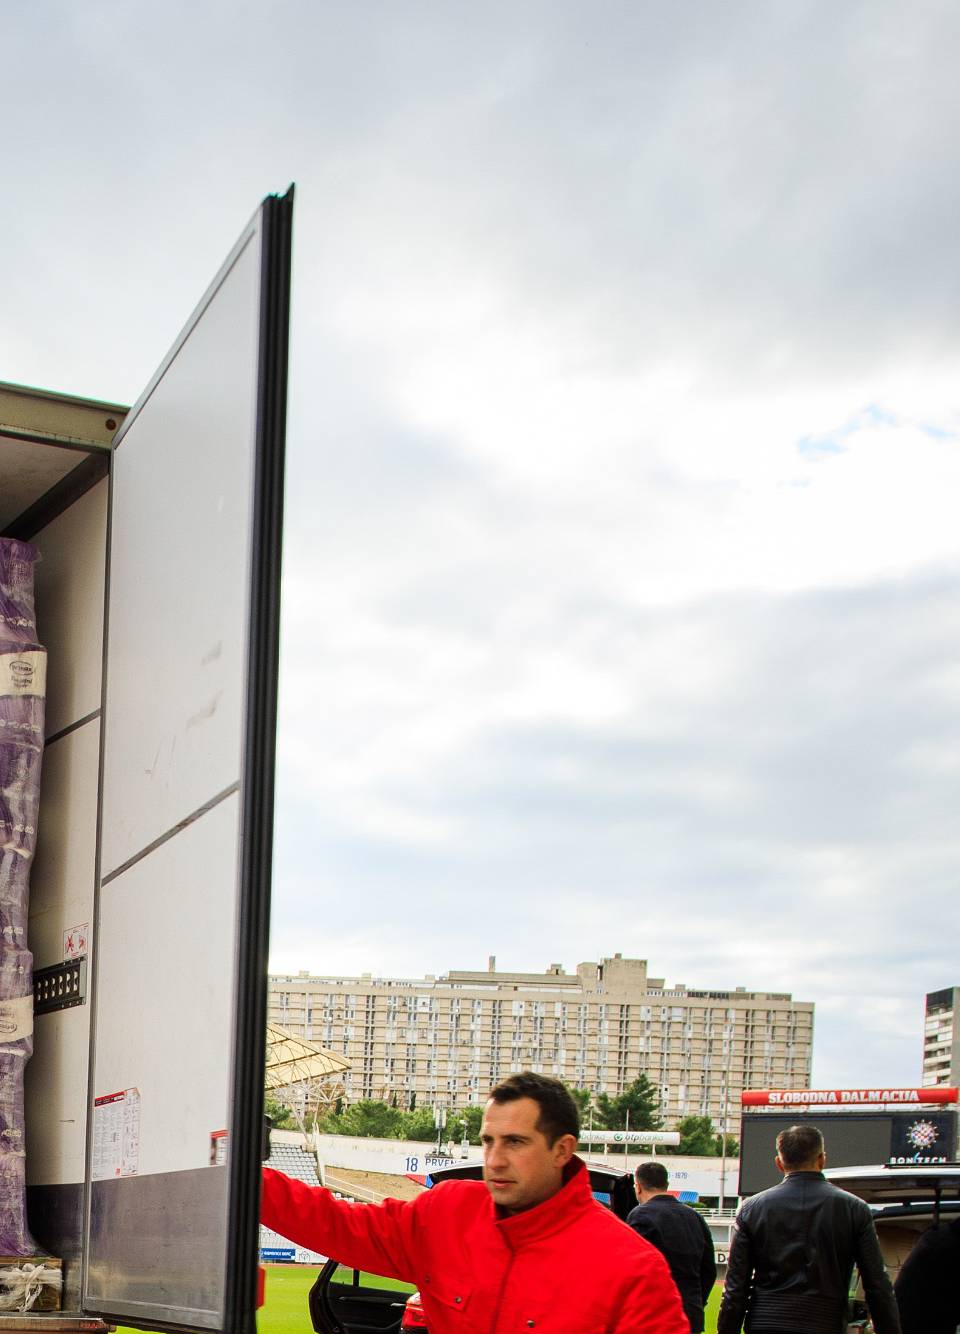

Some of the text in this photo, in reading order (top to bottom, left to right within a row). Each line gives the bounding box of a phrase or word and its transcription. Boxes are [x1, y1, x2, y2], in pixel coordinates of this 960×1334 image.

[768, 1090, 920, 1104] SLOBODNA DALMACIJA
[405, 1157, 419, 1172] 18
